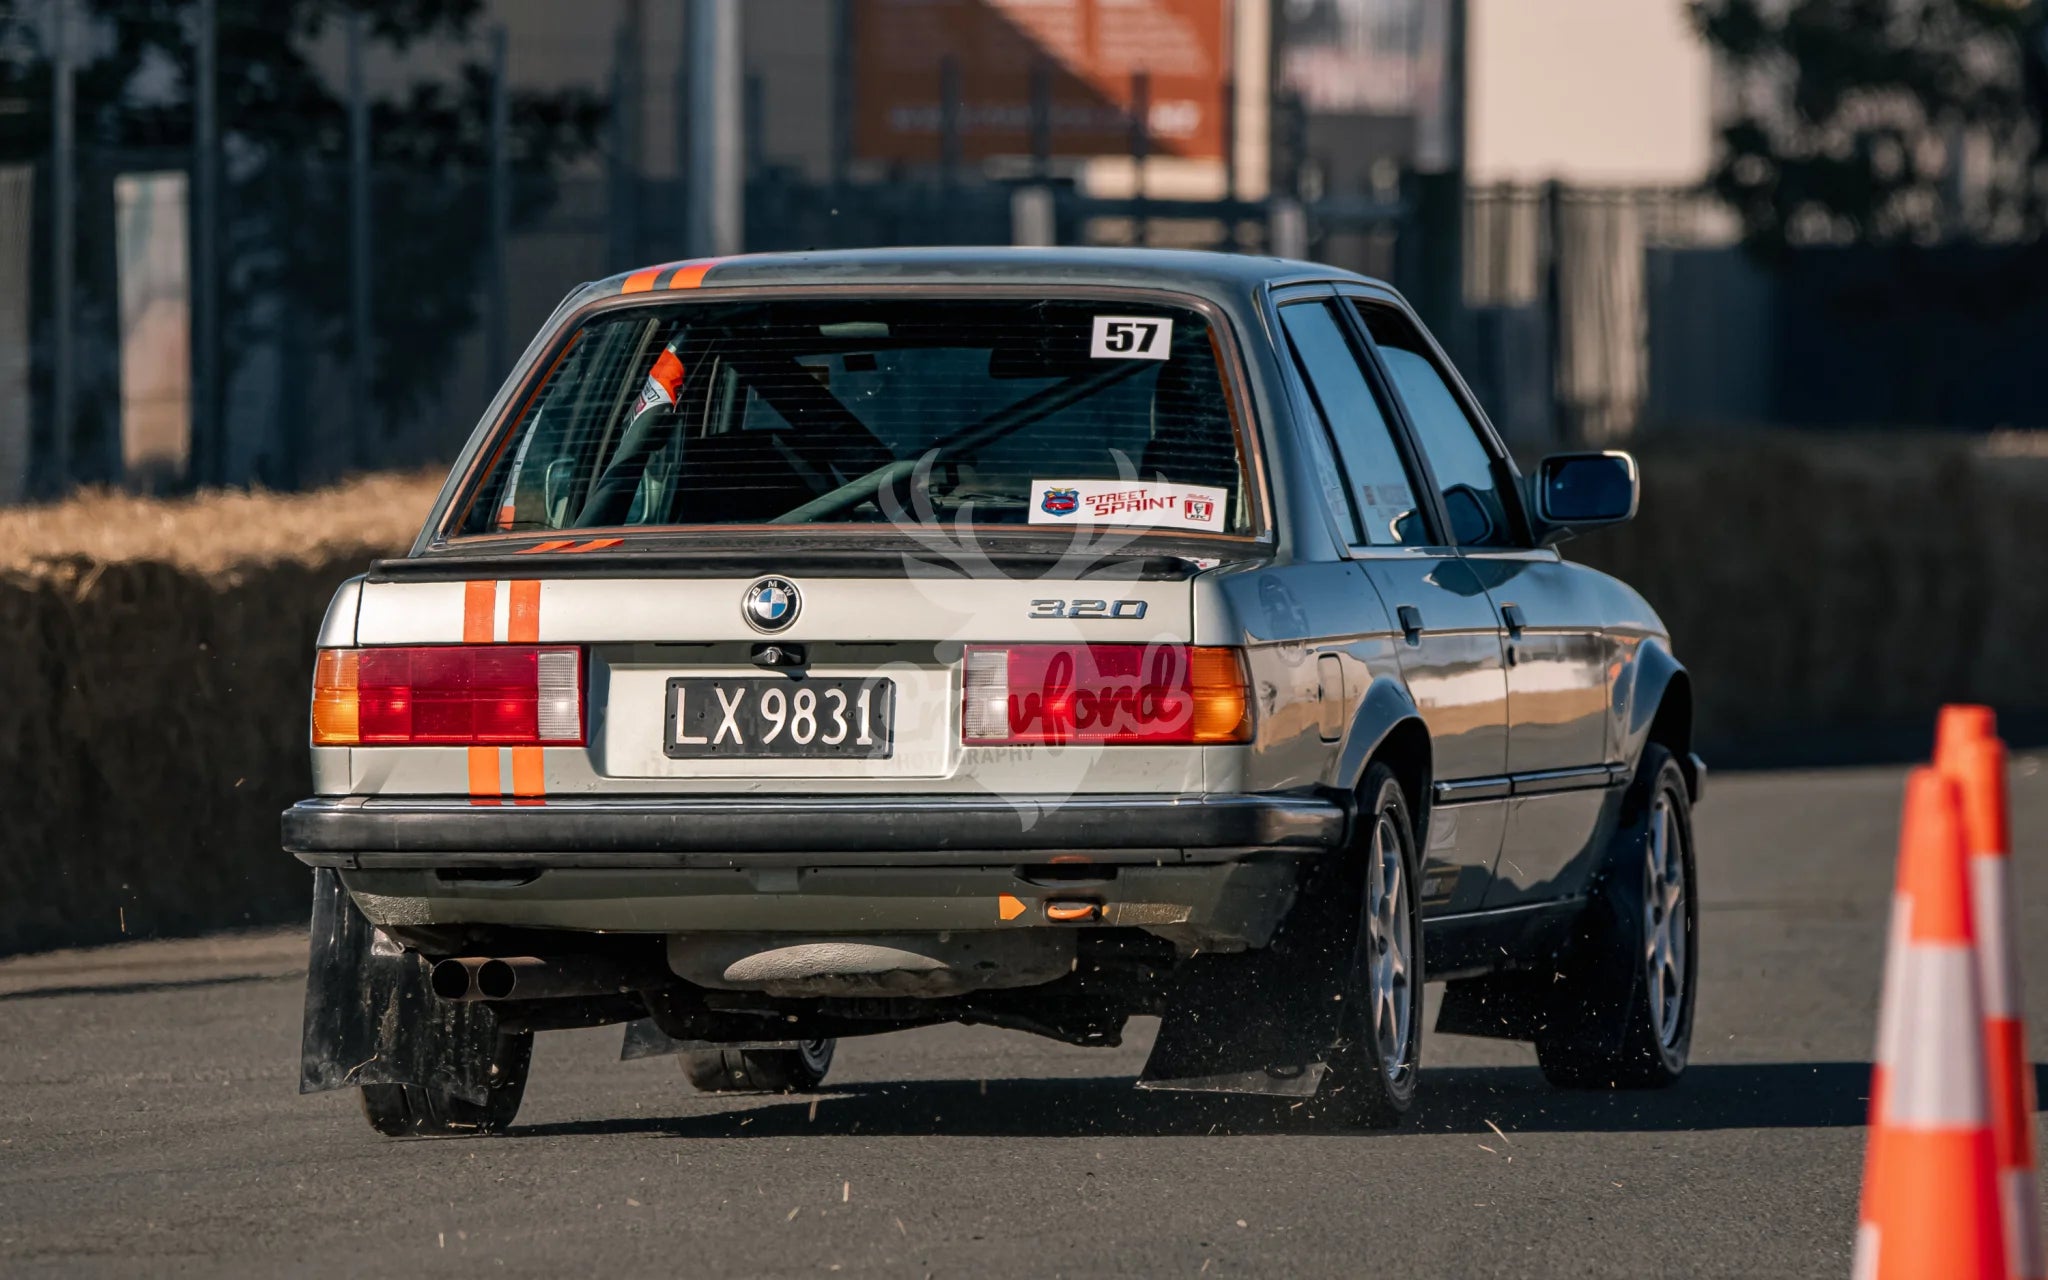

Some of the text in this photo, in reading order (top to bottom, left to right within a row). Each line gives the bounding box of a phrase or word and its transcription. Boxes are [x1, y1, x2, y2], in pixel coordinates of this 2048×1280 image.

[1105, 322, 1159, 352] 57
[1085, 489, 1147, 506] STREET
[1094, 496, 1177, 516] SPRINT
[752, 580, 794, 597] BMW
[1027, 599, 1148, 620] 320
[676, 687, 873, 745] LX 9831
